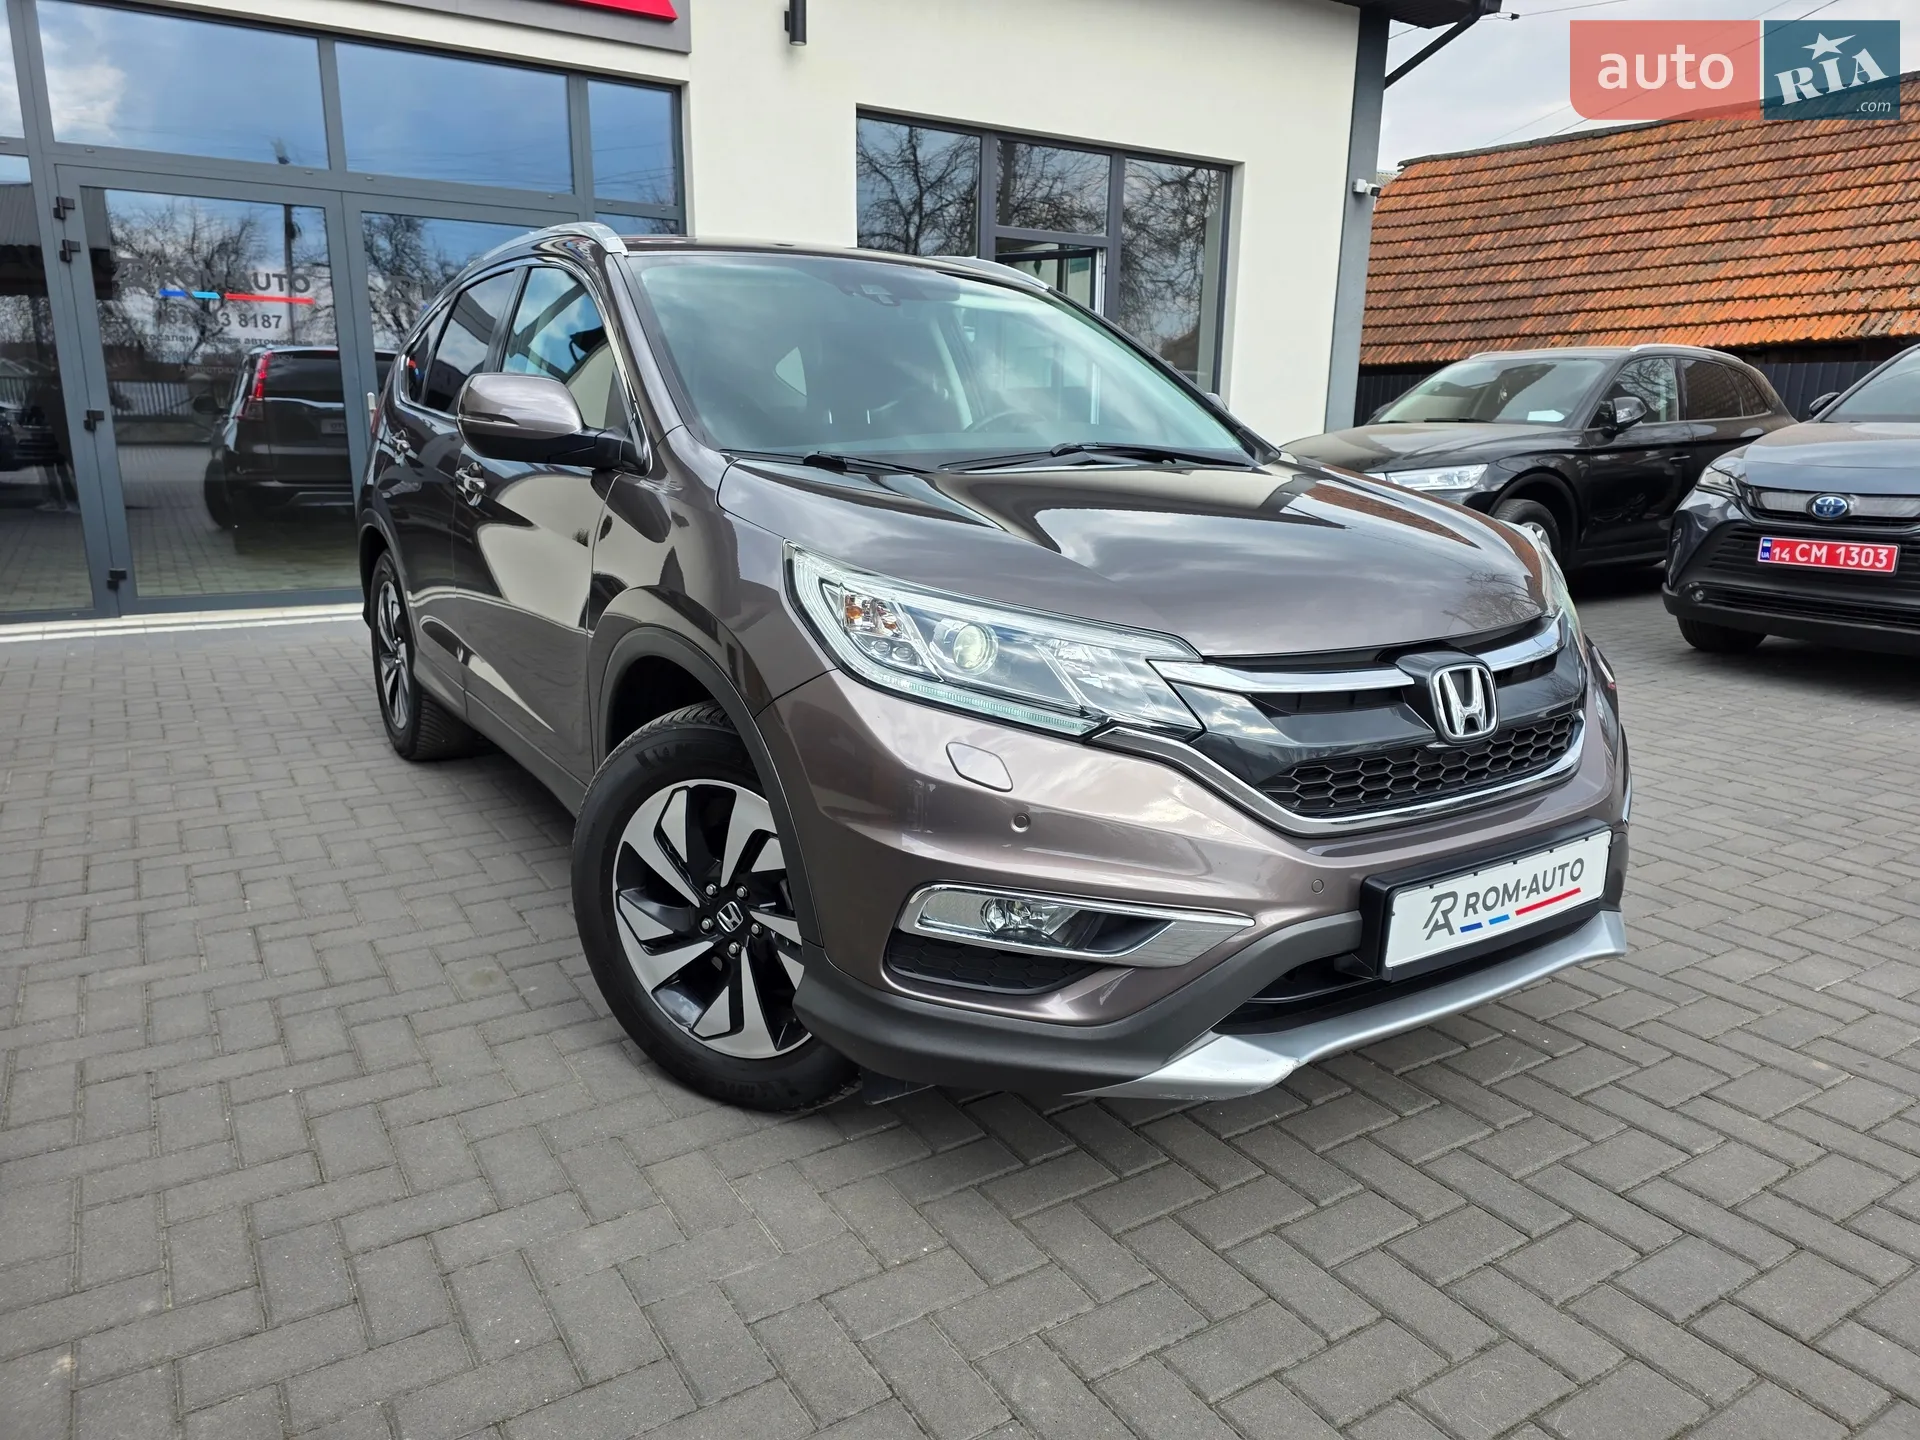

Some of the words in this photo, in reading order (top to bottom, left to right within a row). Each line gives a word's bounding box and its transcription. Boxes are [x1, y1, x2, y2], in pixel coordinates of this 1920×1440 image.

[238, 313, 283, 330] 8187
[1772, 546, 1790, 562] 14
[1795, 543, 1828, 564] CM
[1836, 546, 1889, 568] 1303
[1463, 857, 1585, 918] ROM-AUTO
